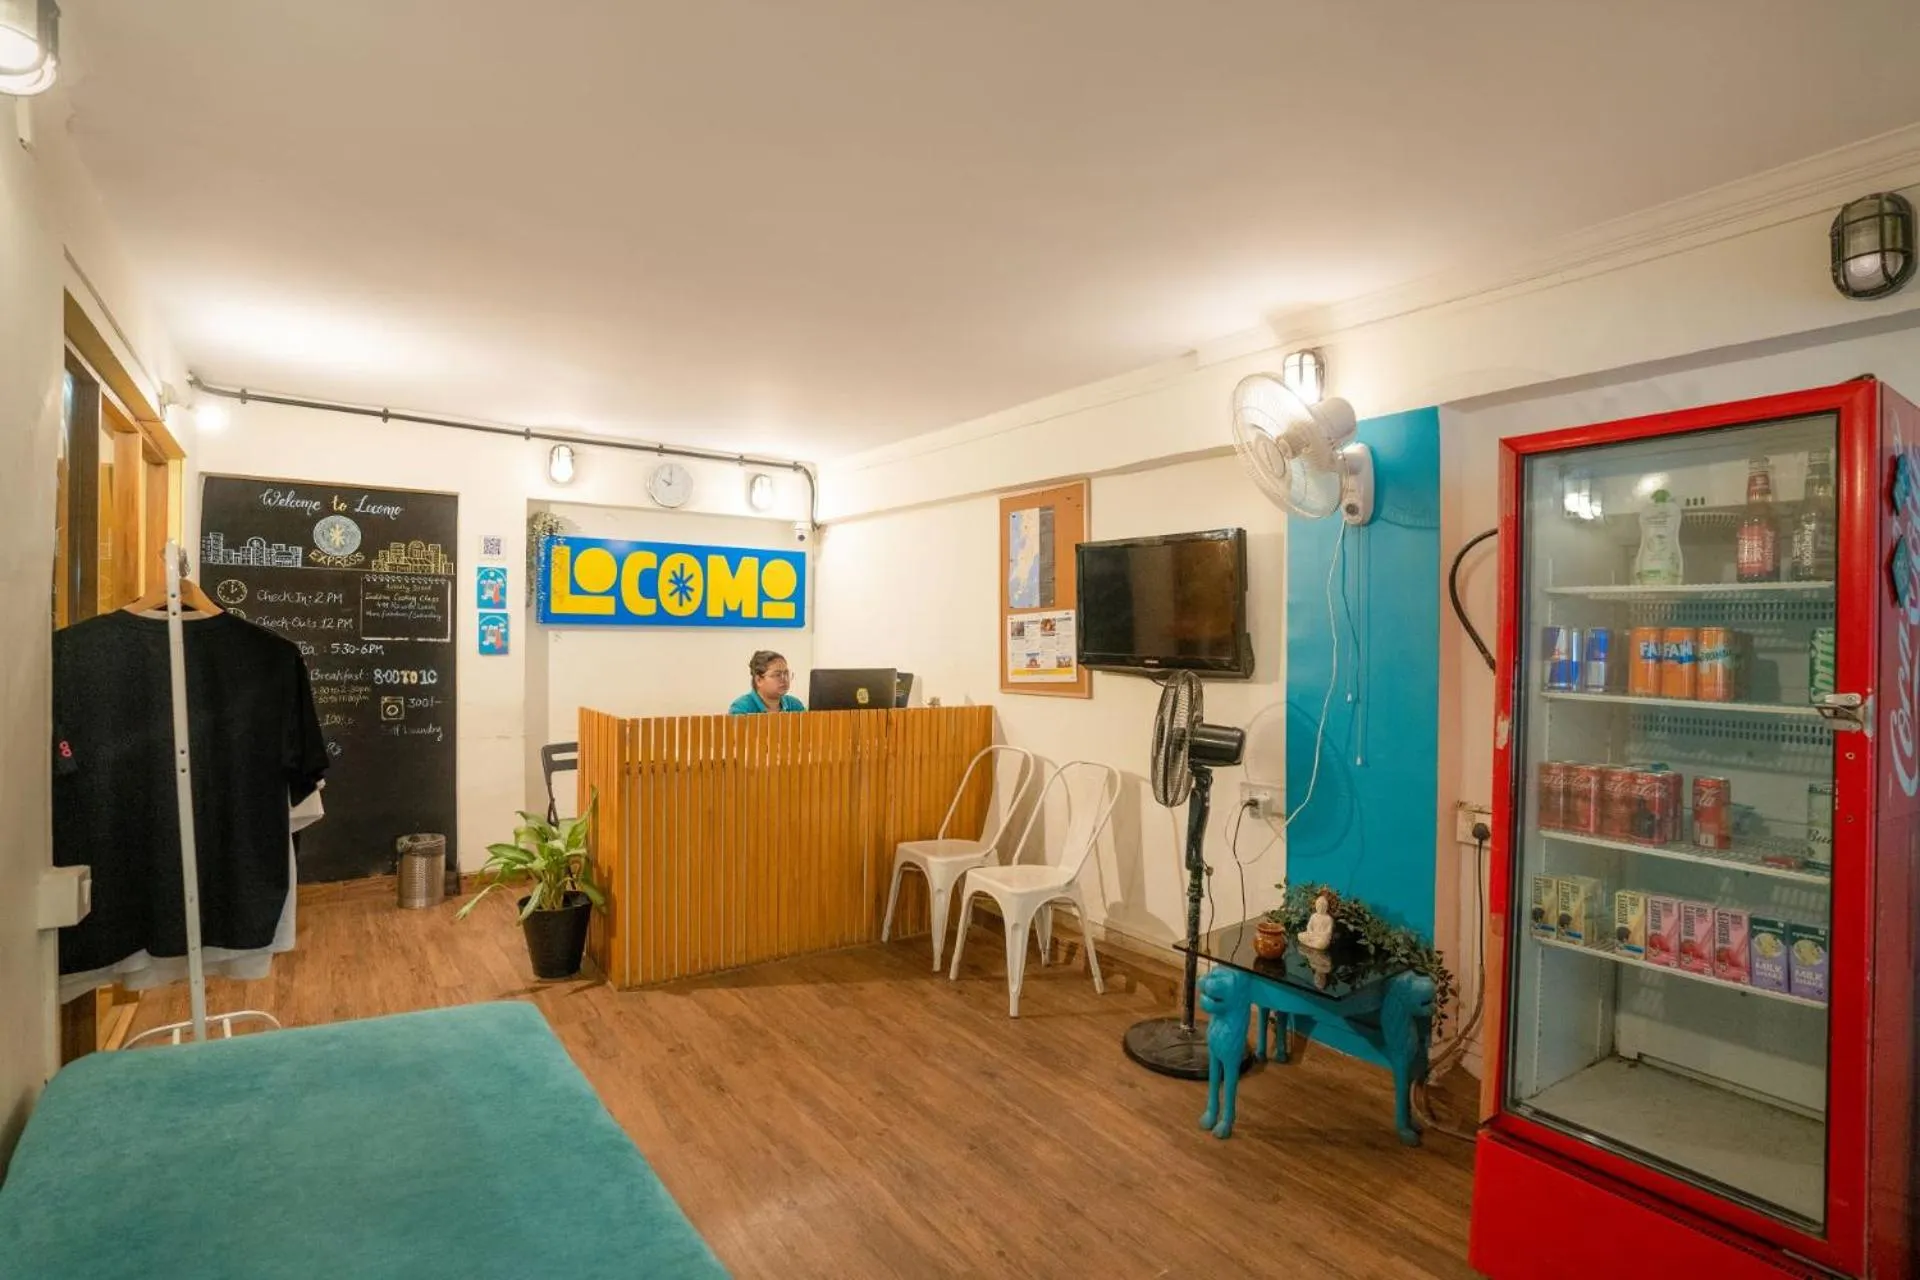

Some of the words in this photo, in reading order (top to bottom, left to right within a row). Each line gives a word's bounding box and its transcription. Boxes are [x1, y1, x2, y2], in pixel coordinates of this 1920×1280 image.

[260, 489, 321, 516] Welcome
[332, 495, 348, 511] to
[355, 495, 402, 520] Locomo
[308, 548, 365, 568] EXPRESS
[550, 545, 797, 619] LOCOMO
[314, 591, 324, 603] 2
[326, 592, 343, 605] PM
[322, 617, 335, 629] 12
[337, 618, 353, 629] PM
